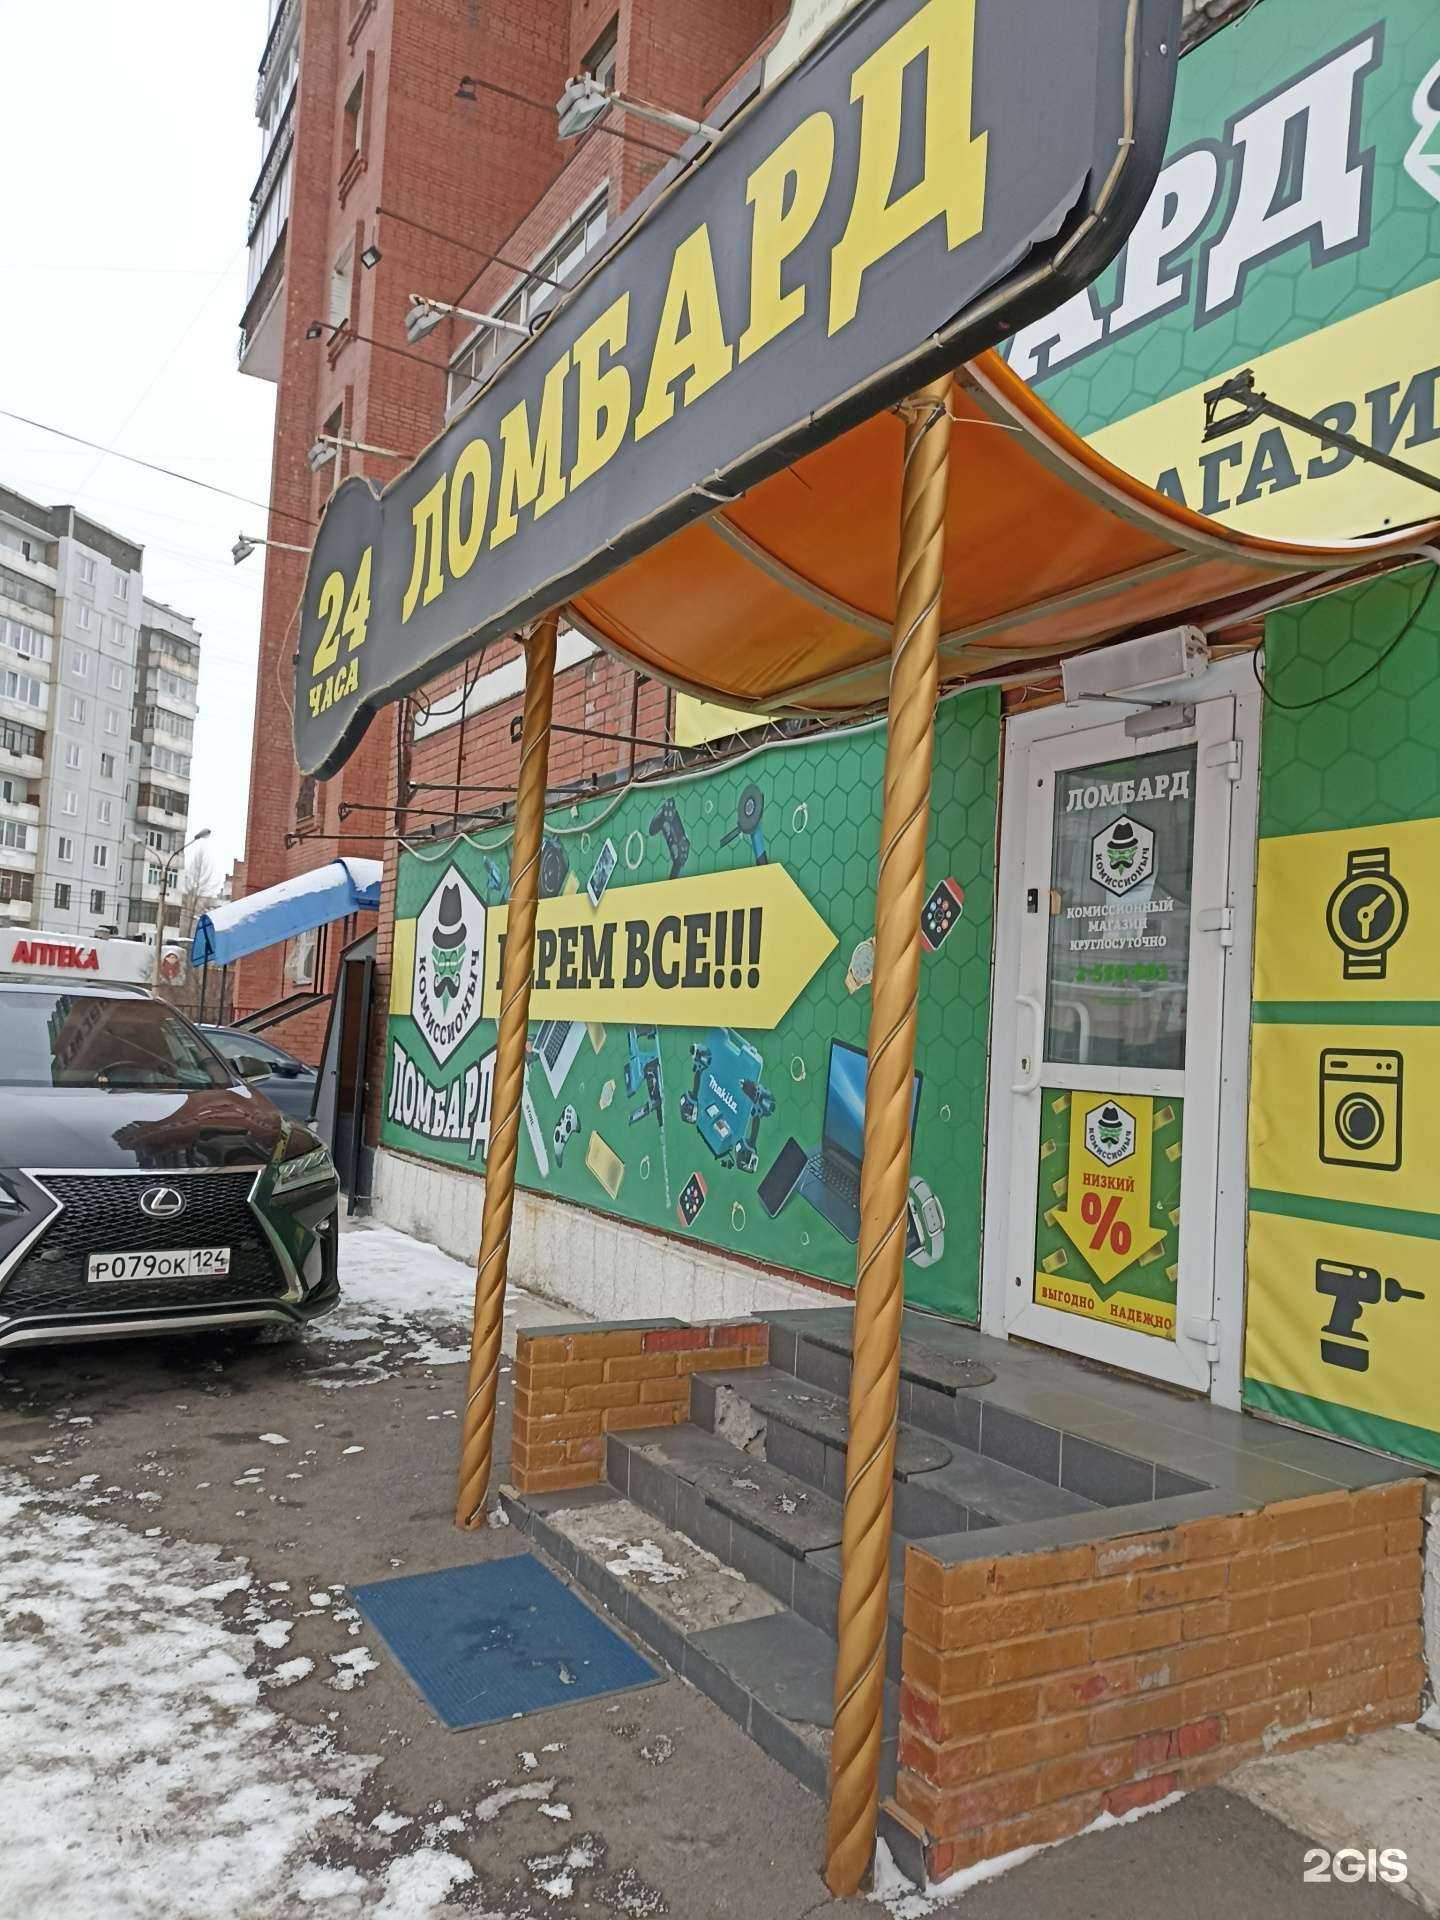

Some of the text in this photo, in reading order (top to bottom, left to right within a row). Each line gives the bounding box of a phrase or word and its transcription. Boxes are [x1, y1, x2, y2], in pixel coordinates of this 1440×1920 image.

[403, 0, 988, 624] ЛОМБАРД
[312, 545, 372, 677] 24
[309, 656, 359, 718] ЧАСА
[1066, 771, 1190, 812] ЛОМБАРД
[11, 939, 100, 971] АПТЕКА
[622, 906, 763, 990] ВСЕ!!!
[1069, 935, 1168, 952] КРУГЛОСУТОЧНО
[418, 950, 480, 1047] КОМИССИОНЫЧ
[388, 1041, 497, 1160] ЛОМБАРД
[1082, 1172, 1136, 1193] НИЗКИЙ
[1081, 1191, 1132, 1256] %
[1041, 1286, 1173, 1331] ВЫГОДНО НАДЕЖНО
